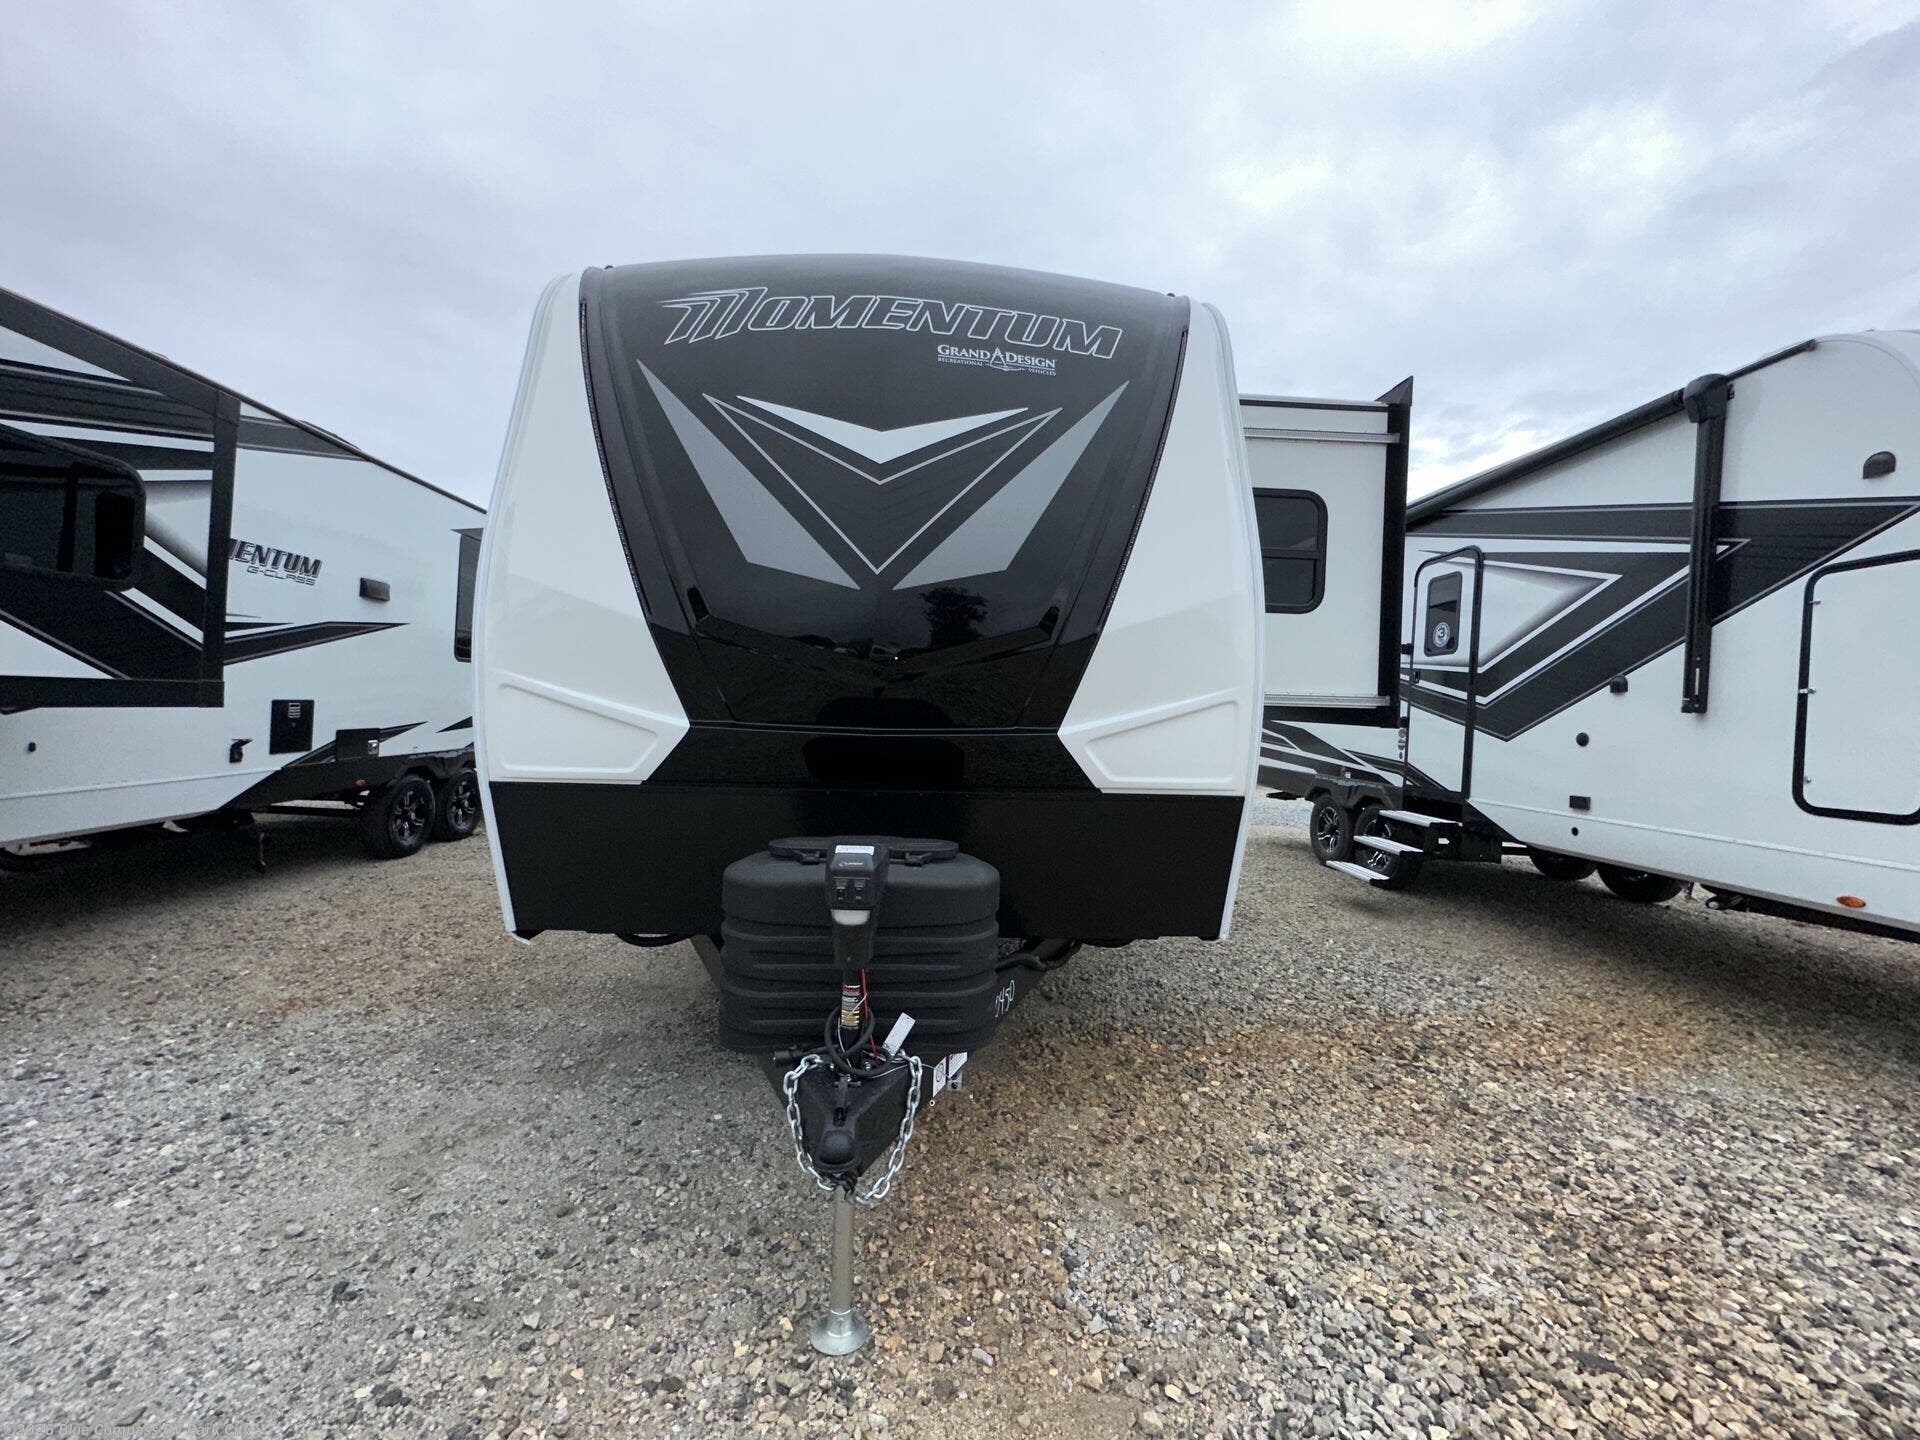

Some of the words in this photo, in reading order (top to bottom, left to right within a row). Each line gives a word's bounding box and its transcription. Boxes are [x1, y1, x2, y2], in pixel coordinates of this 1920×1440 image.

[656, 286, 1123, 359] MOMENTUM
[937, 344, 991, 360] GRAND
[1005, 351, 1056, 368] DESIGN
[227, 538, 322, 579] ENTUM
[246, 565, 317, 586] G-CLASS
